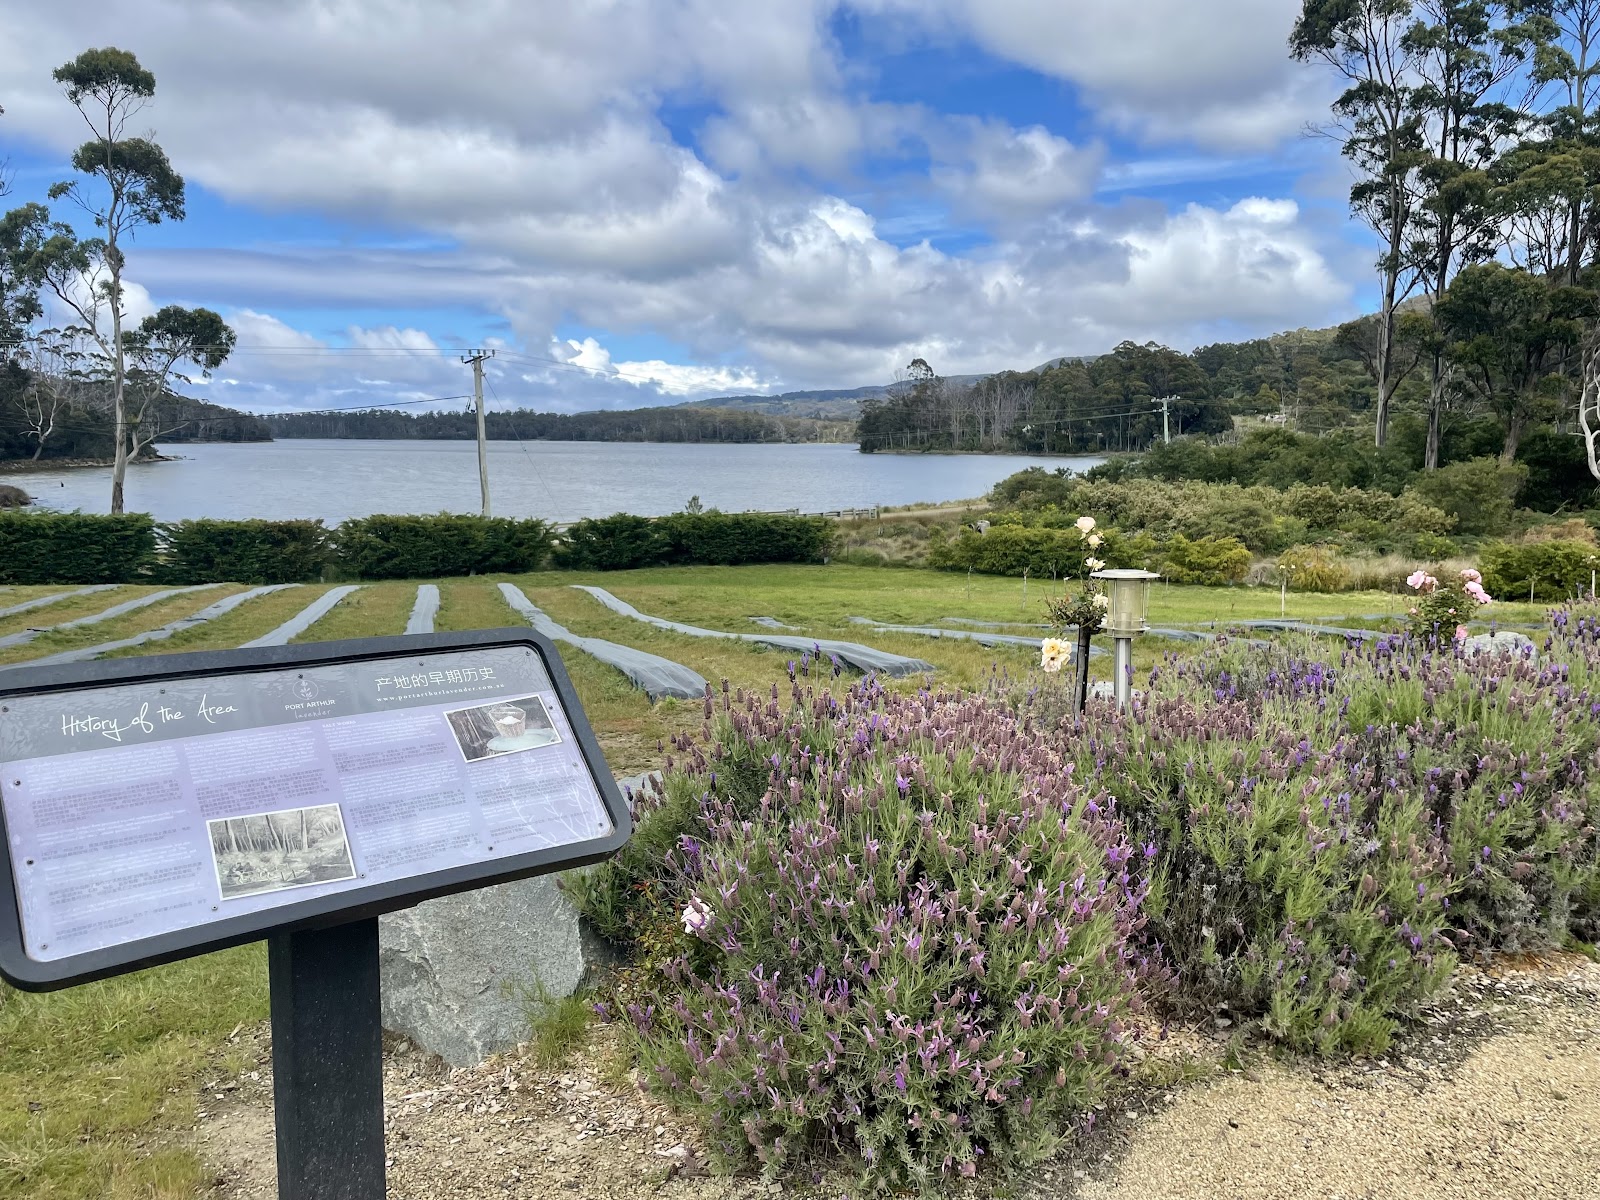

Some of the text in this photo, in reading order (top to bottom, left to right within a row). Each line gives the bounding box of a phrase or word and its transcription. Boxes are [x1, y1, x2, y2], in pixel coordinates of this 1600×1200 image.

[374, 666, 496, 691] 产地的早期历史
[376, 683, 505, 702] www.portarthurlavender.com.au
[285, 699, 336, 711] PORT ARTHUR
[294, 708, 331, 720] lavender
[61, 693, 239, 742] History of the Area
